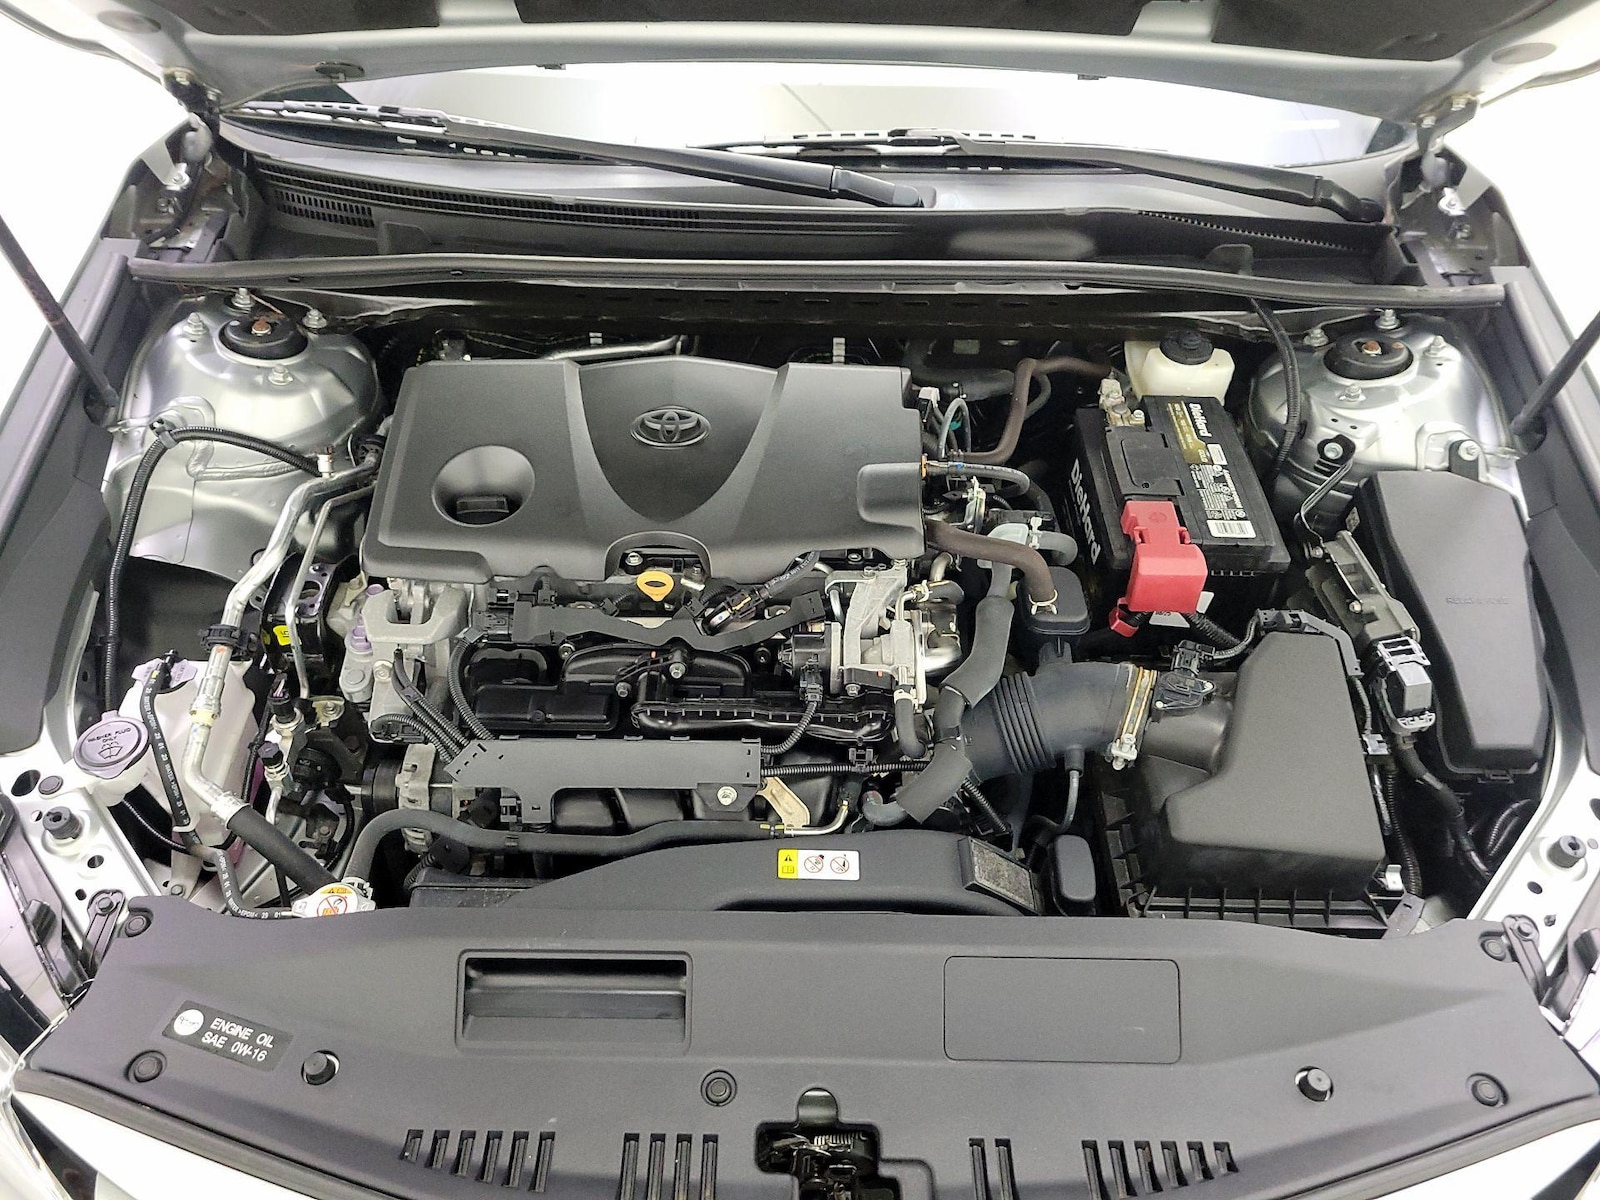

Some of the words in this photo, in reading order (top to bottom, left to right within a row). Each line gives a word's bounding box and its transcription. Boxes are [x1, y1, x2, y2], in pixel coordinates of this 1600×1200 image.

[1189, 403, 1212, 438] DieHard
[1071, 458, 1101, 565] DieHard
[87, 732, 112, 743] WASHER
[115, 727, 132, 736] FLUID
[201, 1031, 228, 1049] SAE
[231, 1041, 268, 1062] 0W-16
[210, 1017, 254, 1040] ENGINE
[256, 1033, 275, 1049] OIL
